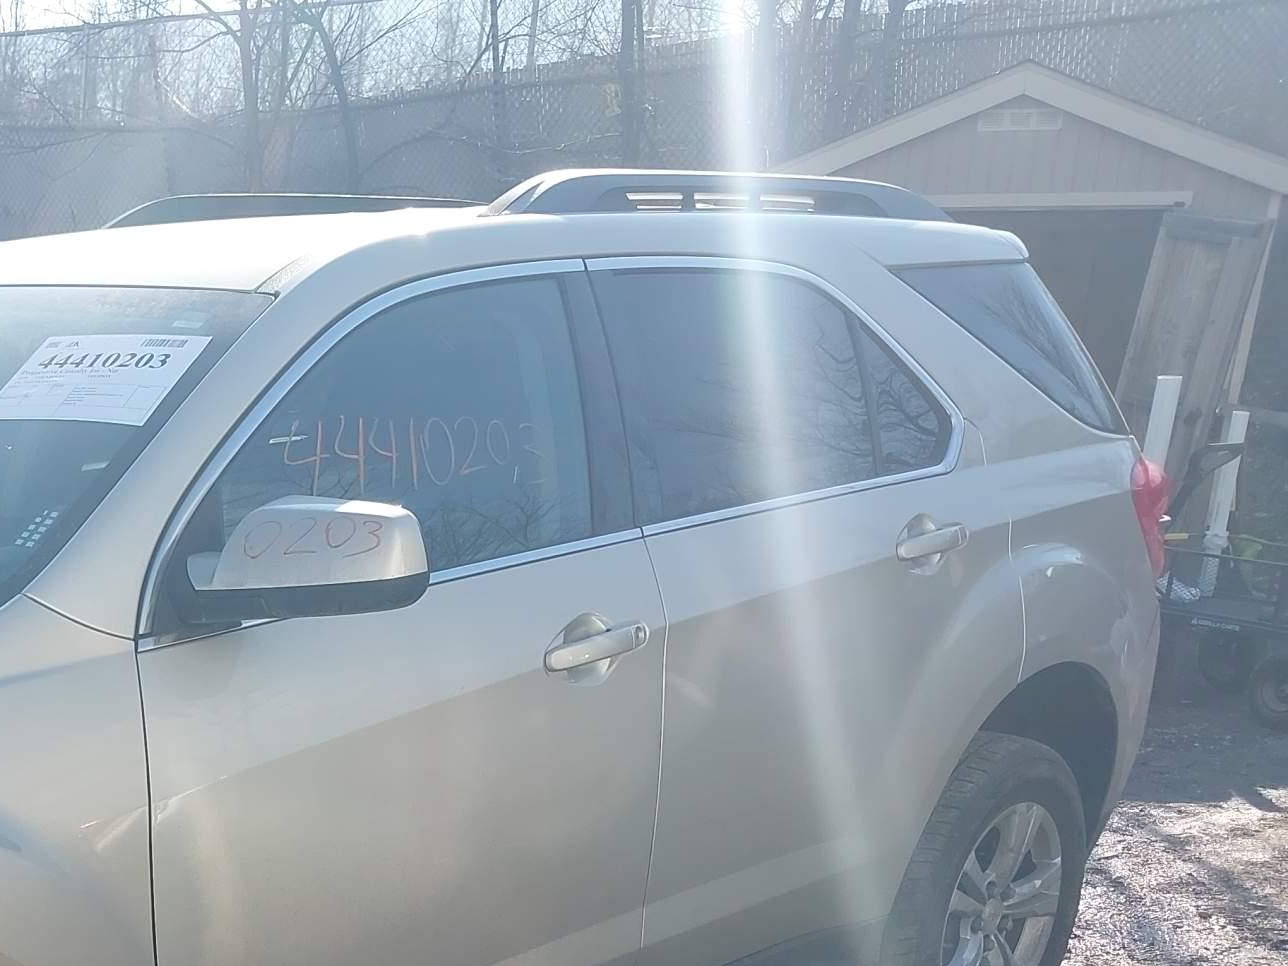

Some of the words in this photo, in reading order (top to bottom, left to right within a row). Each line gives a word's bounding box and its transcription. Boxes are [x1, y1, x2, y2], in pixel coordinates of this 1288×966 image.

[38, 352, 172, 369] 44410203
[283, 415, 546, 496] 44410203
[243, 516, 383, 559] 0203
